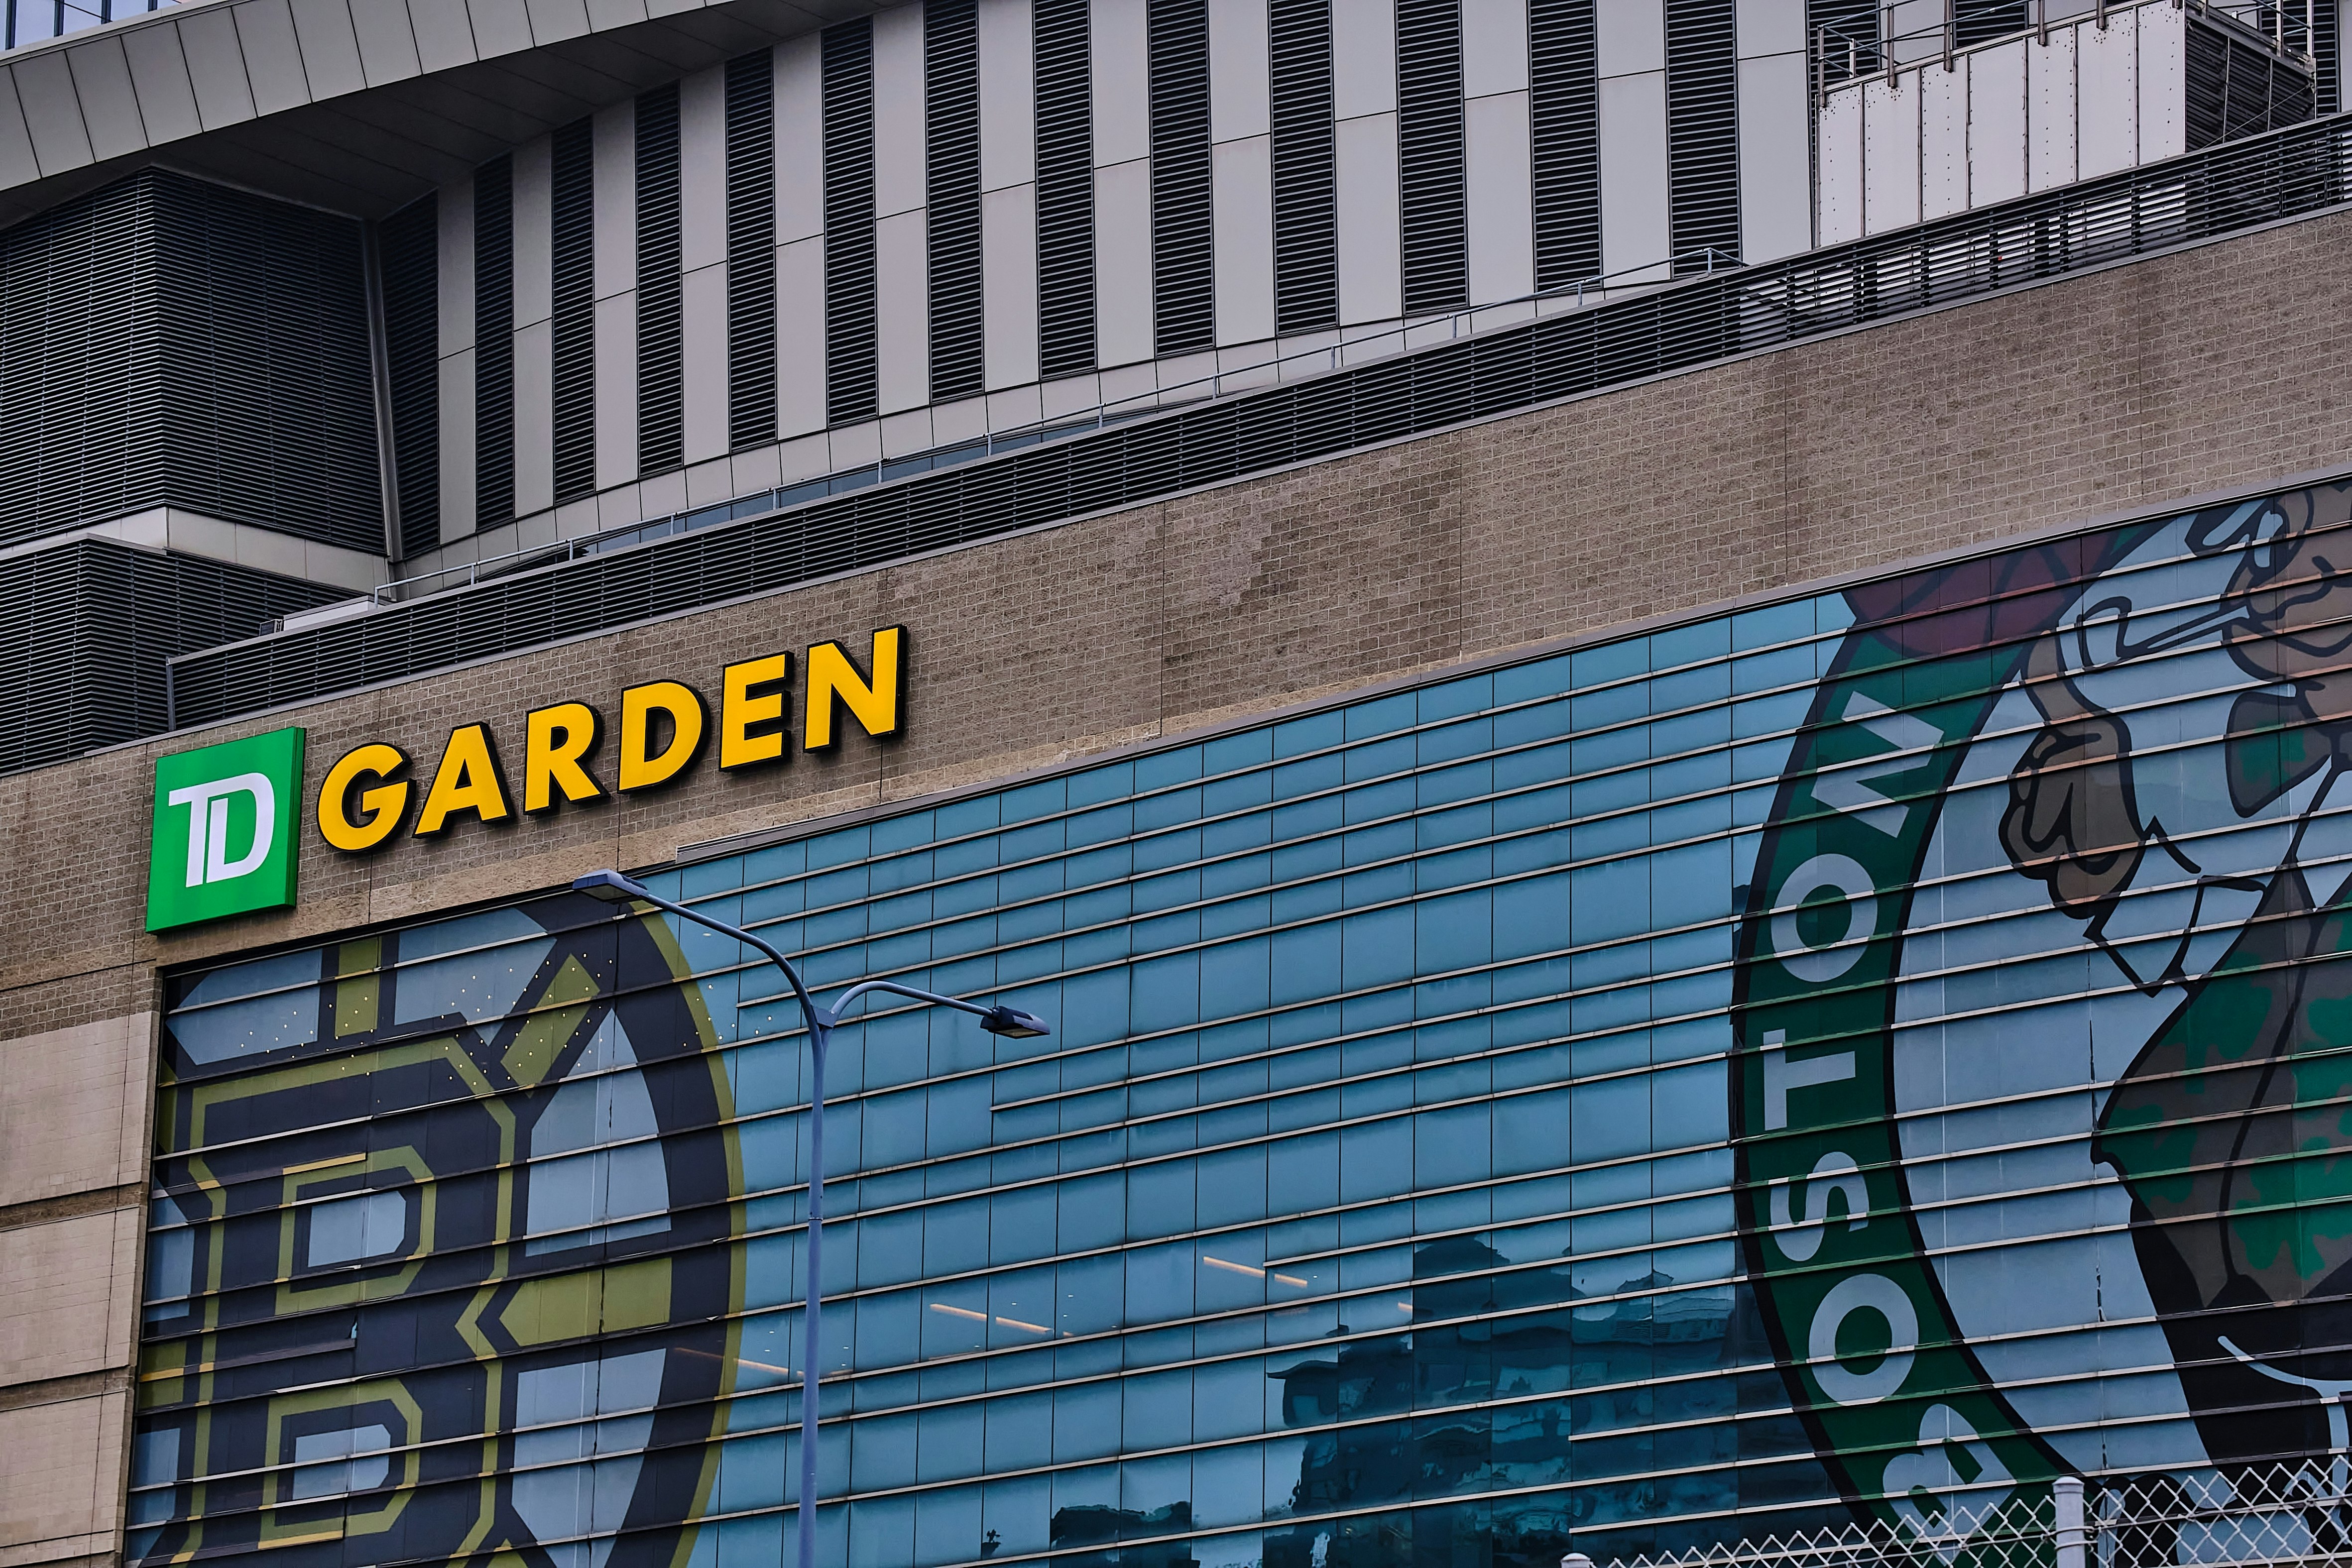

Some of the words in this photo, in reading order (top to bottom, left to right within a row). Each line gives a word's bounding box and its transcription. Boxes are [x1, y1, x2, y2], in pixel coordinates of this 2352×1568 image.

[168, 773, 275, 888] TD
[317, 624, 907, 852] GARDEN
[1763, 690, 2018, 1566] BOSTON
